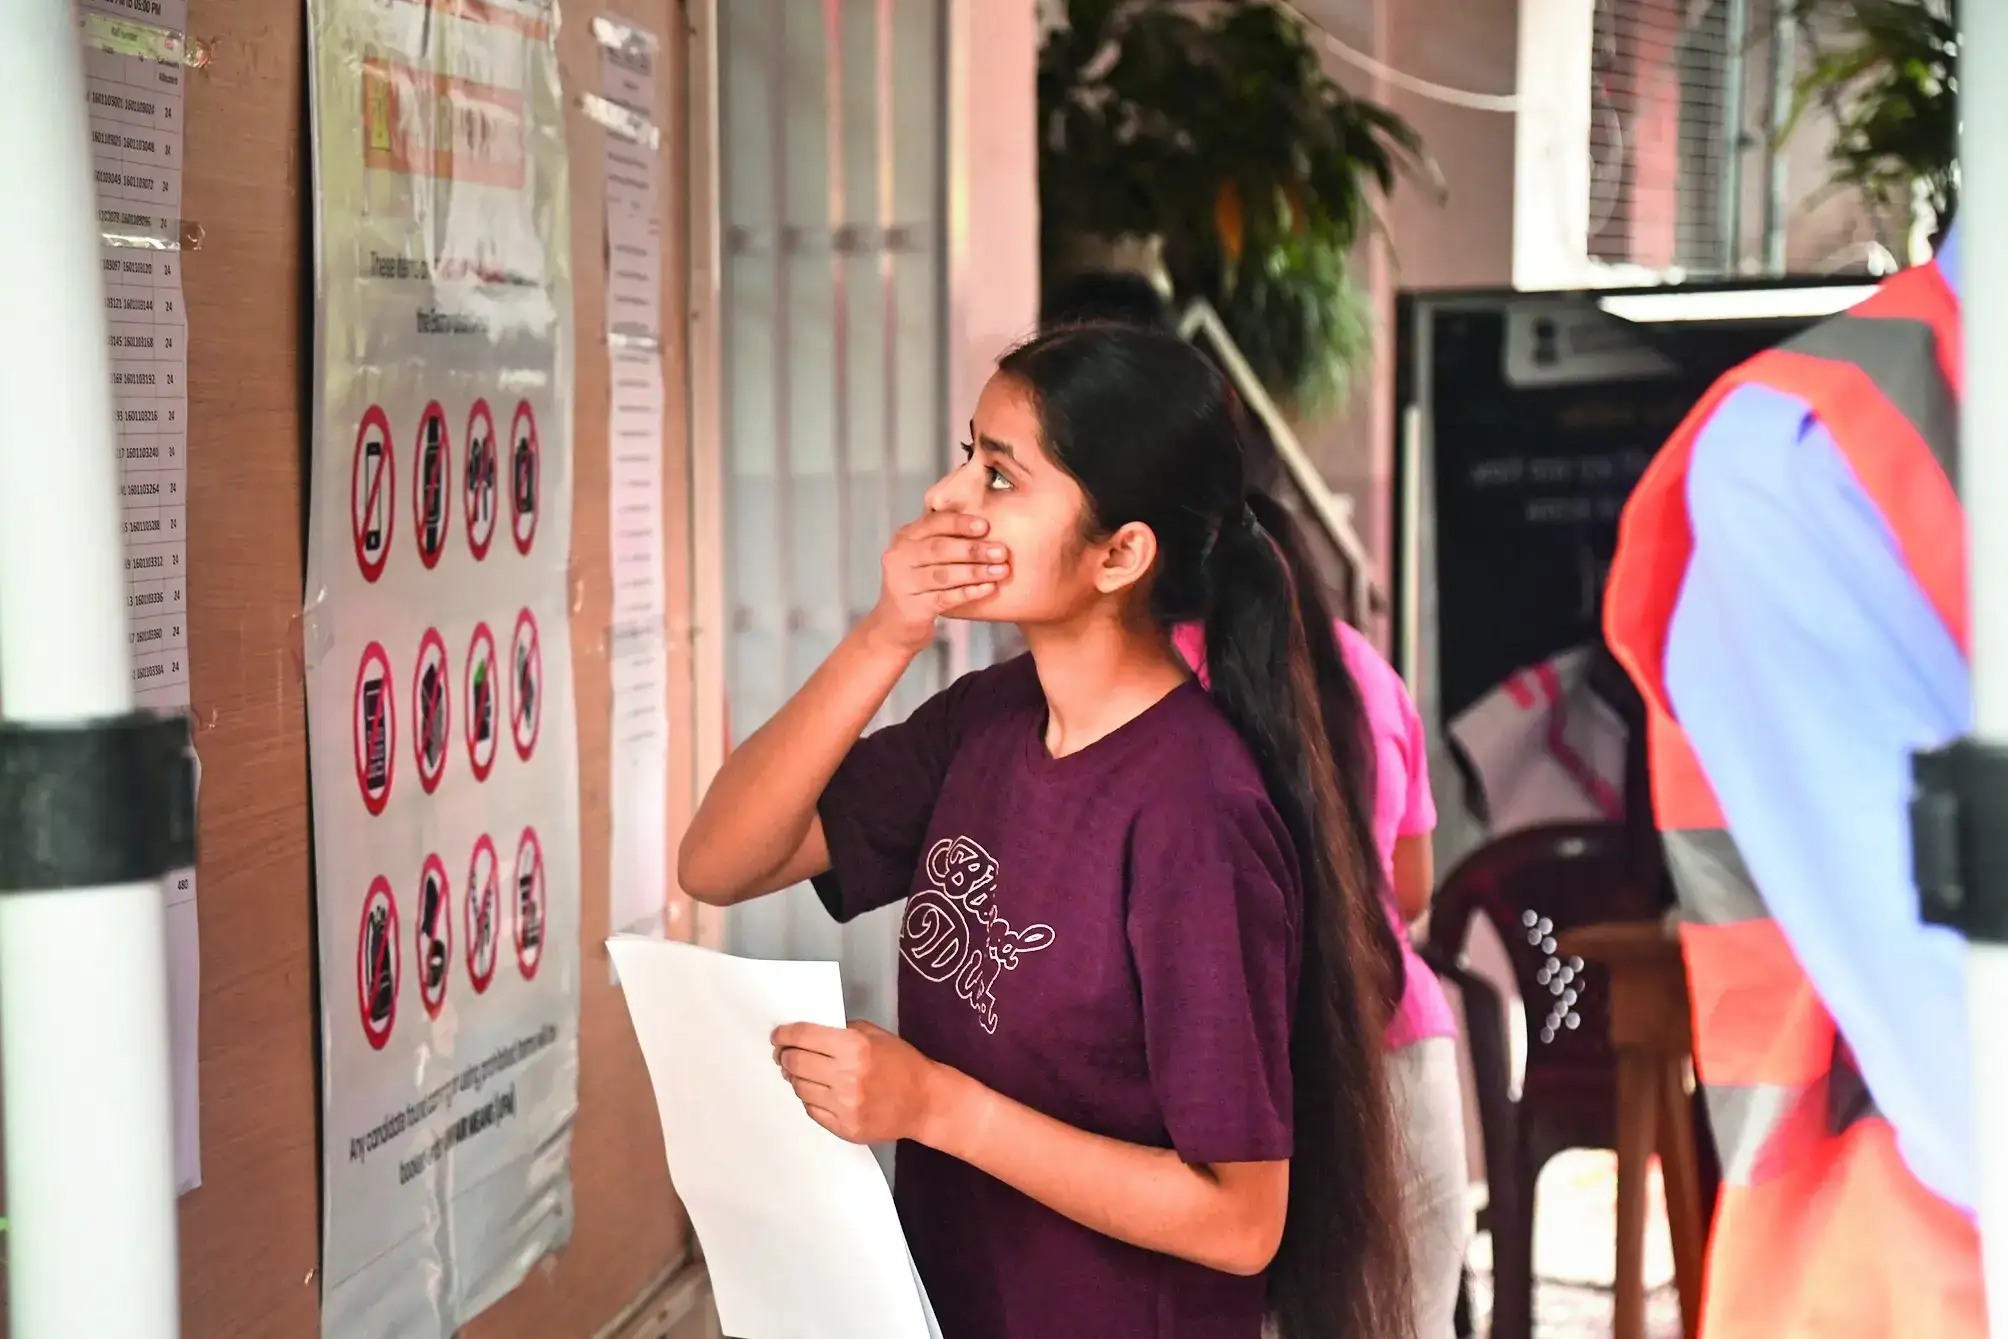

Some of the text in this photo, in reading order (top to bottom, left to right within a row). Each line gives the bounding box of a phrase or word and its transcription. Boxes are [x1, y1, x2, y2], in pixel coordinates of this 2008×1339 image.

[151, 3, 161, 15] PM
[165, 107, 172, 118] 24
[165, 144, 171, 155] 24
[162, 181, 169, 192] 24
[160, 217, 167, 229] 24
[164, 264, 171, 276] 24
[165, 300, 173, 312] 24
[165, 337, 172, 349] 24
[167, 373, 174, 385] 24
[168, 410, 175, 421] 24
[169, 446, 175, 457] 24
[170, 483, 177, 493] 24
[170, 518, 177, 529] 24
[172, 554, 179, 565] 24
[174, 590, 181, 601] 24
[172, 625, 180, 637] 24
[172, 661, 179, 673] 24
[349, 1133, 366, 1163] Any
